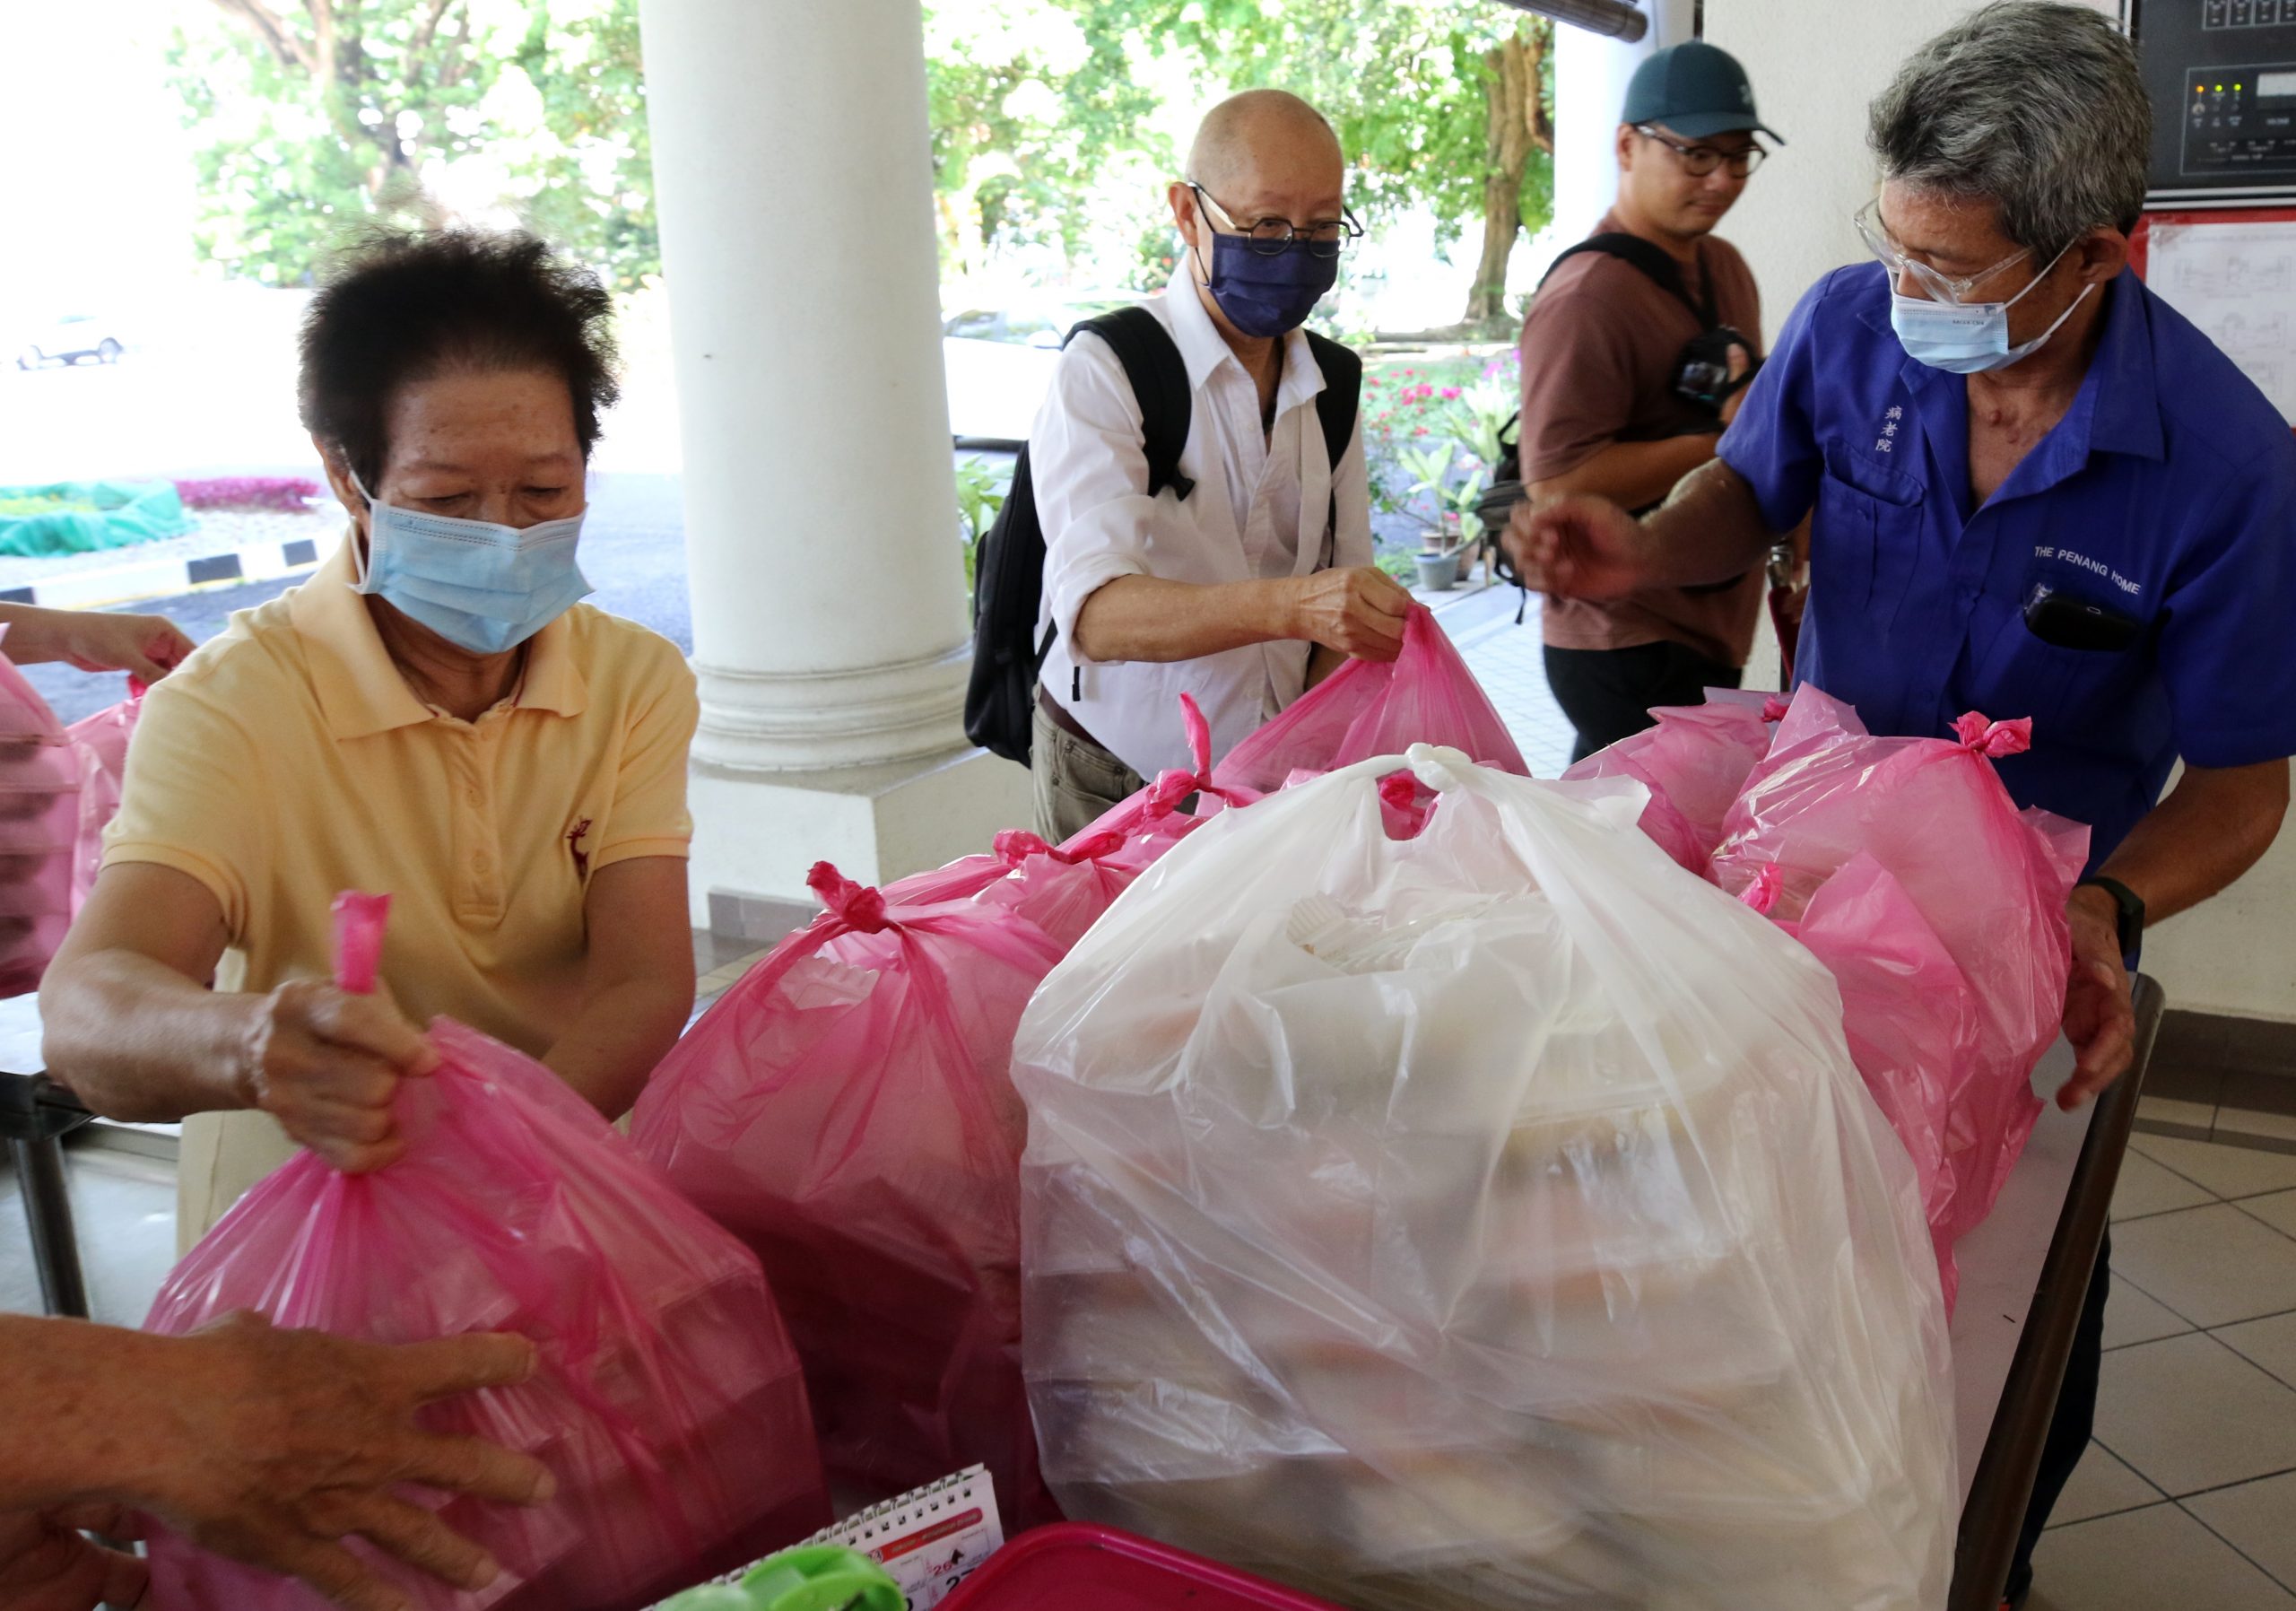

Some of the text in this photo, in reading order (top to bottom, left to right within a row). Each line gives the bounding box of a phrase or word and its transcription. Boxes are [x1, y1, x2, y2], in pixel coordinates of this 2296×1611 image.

[1875, 405, 1902, 452] 病老院
[2034, 545, 2141, 595] THE PENANG HOME
[932, 1562, 953, 1577] 26
[945, 1567, 976, 1594] 2
